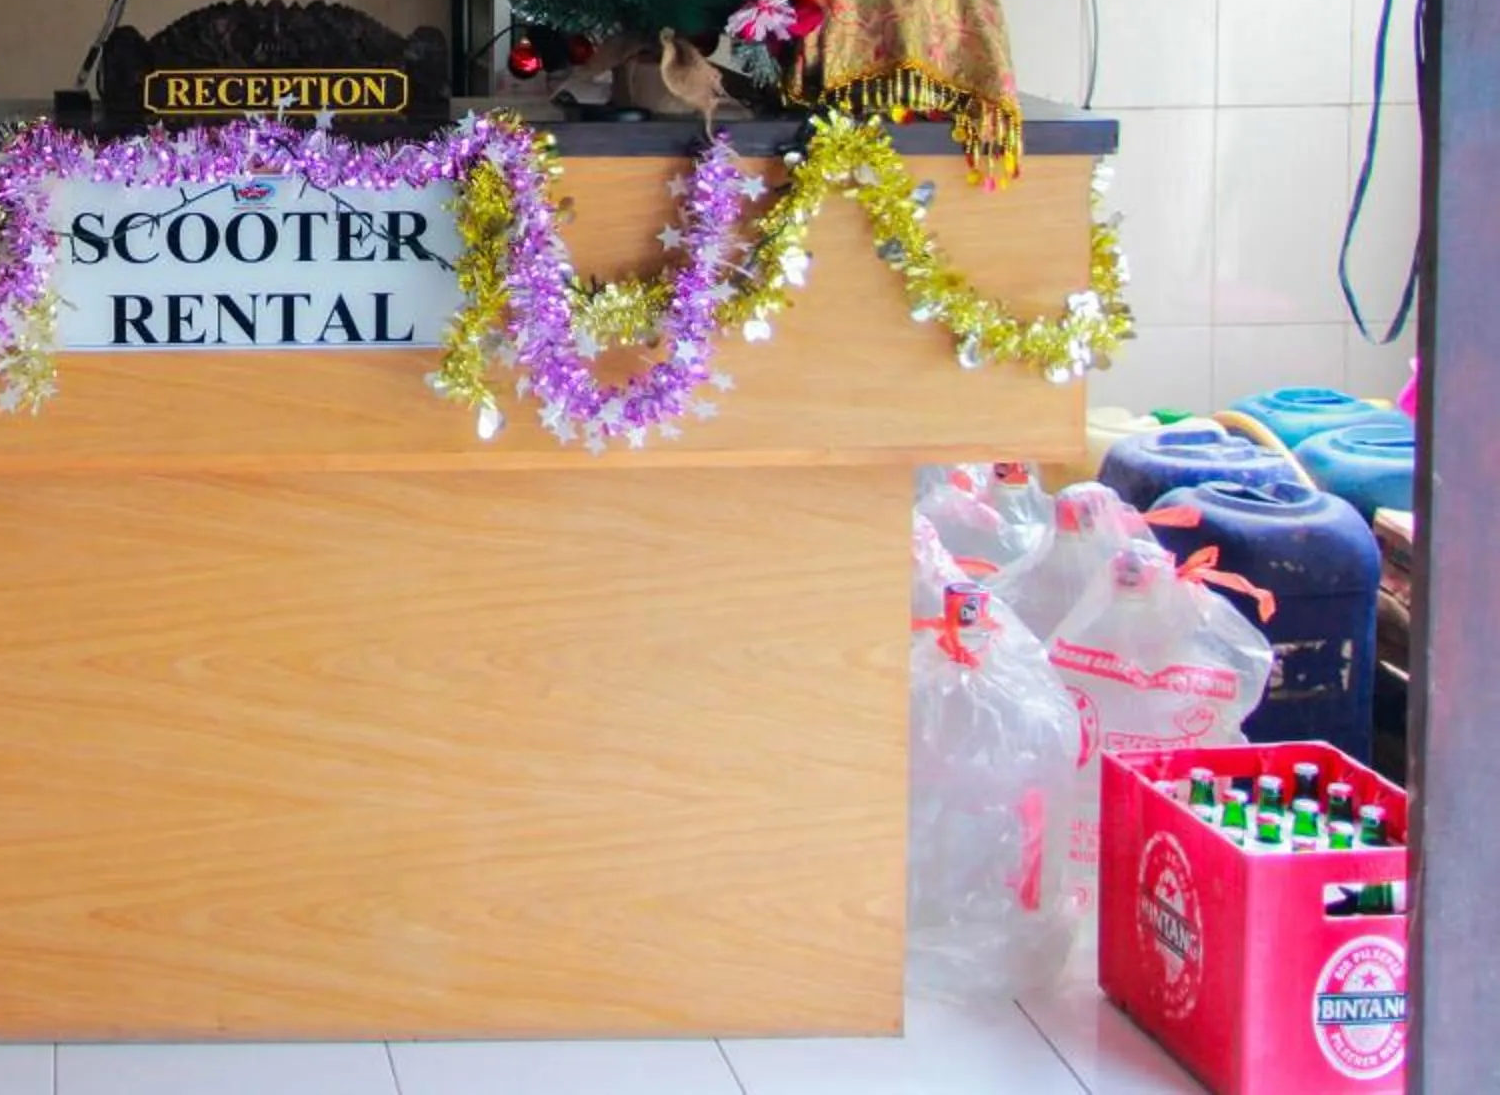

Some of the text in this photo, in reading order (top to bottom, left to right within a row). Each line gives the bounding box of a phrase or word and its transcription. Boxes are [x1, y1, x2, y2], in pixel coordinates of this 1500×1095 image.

[166, 76, 387, 107] RECEPTION
[71, 211, 431, 265] SCOOTER
[110, 292, 415, 345] RENTAL
